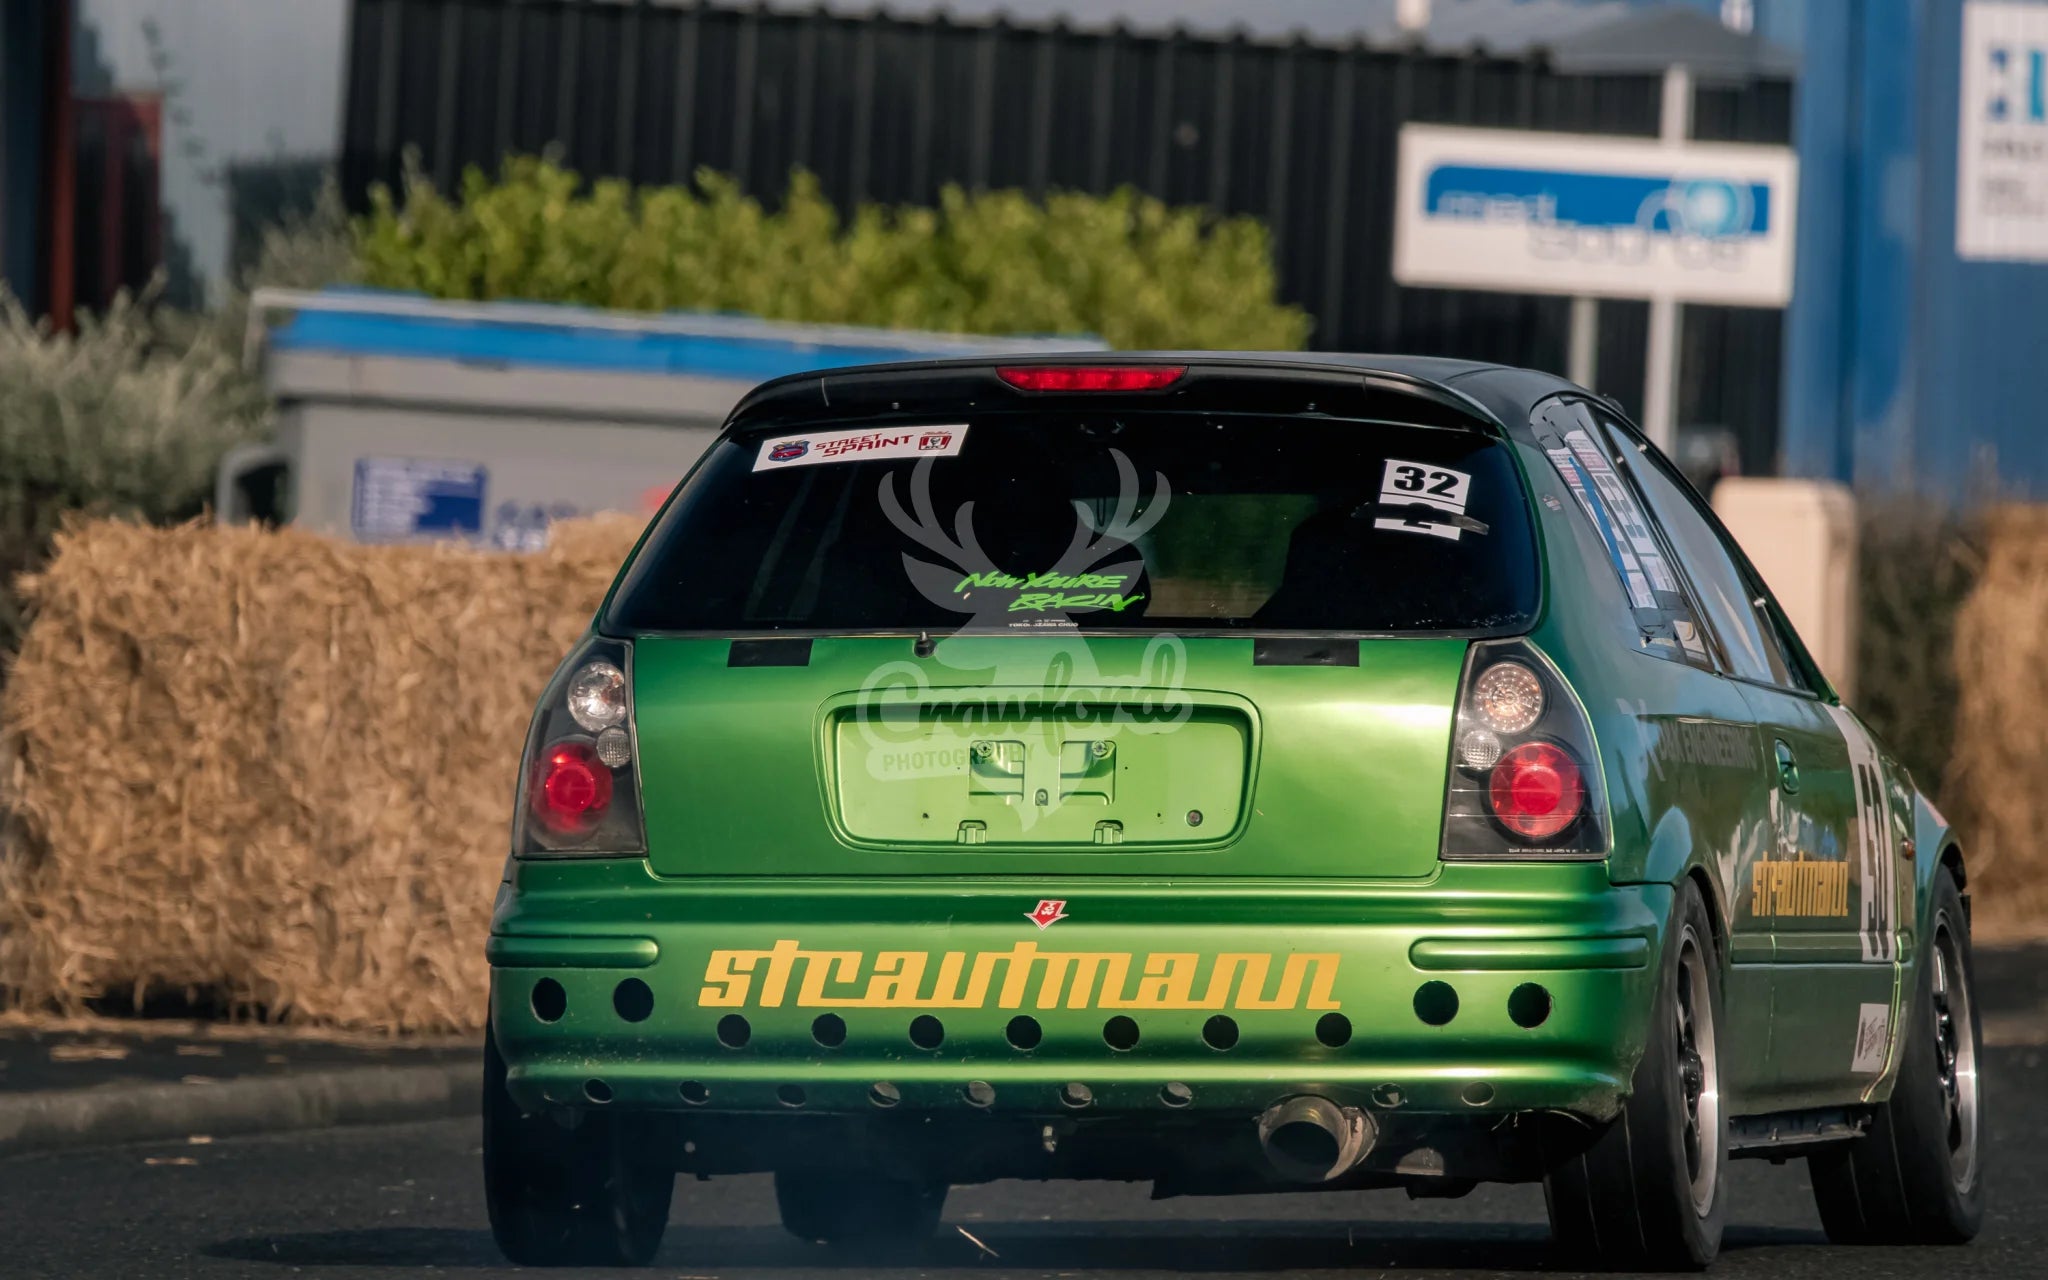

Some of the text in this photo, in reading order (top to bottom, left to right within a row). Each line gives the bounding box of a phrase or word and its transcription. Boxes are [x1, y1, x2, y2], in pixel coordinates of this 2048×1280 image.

[814, 433, 882, 451] STREET
[822, 434, 914, 457] SPRINT
[1394, 465, 1460, 499] 32
[698, 939, 1342, 1010] strautmann
